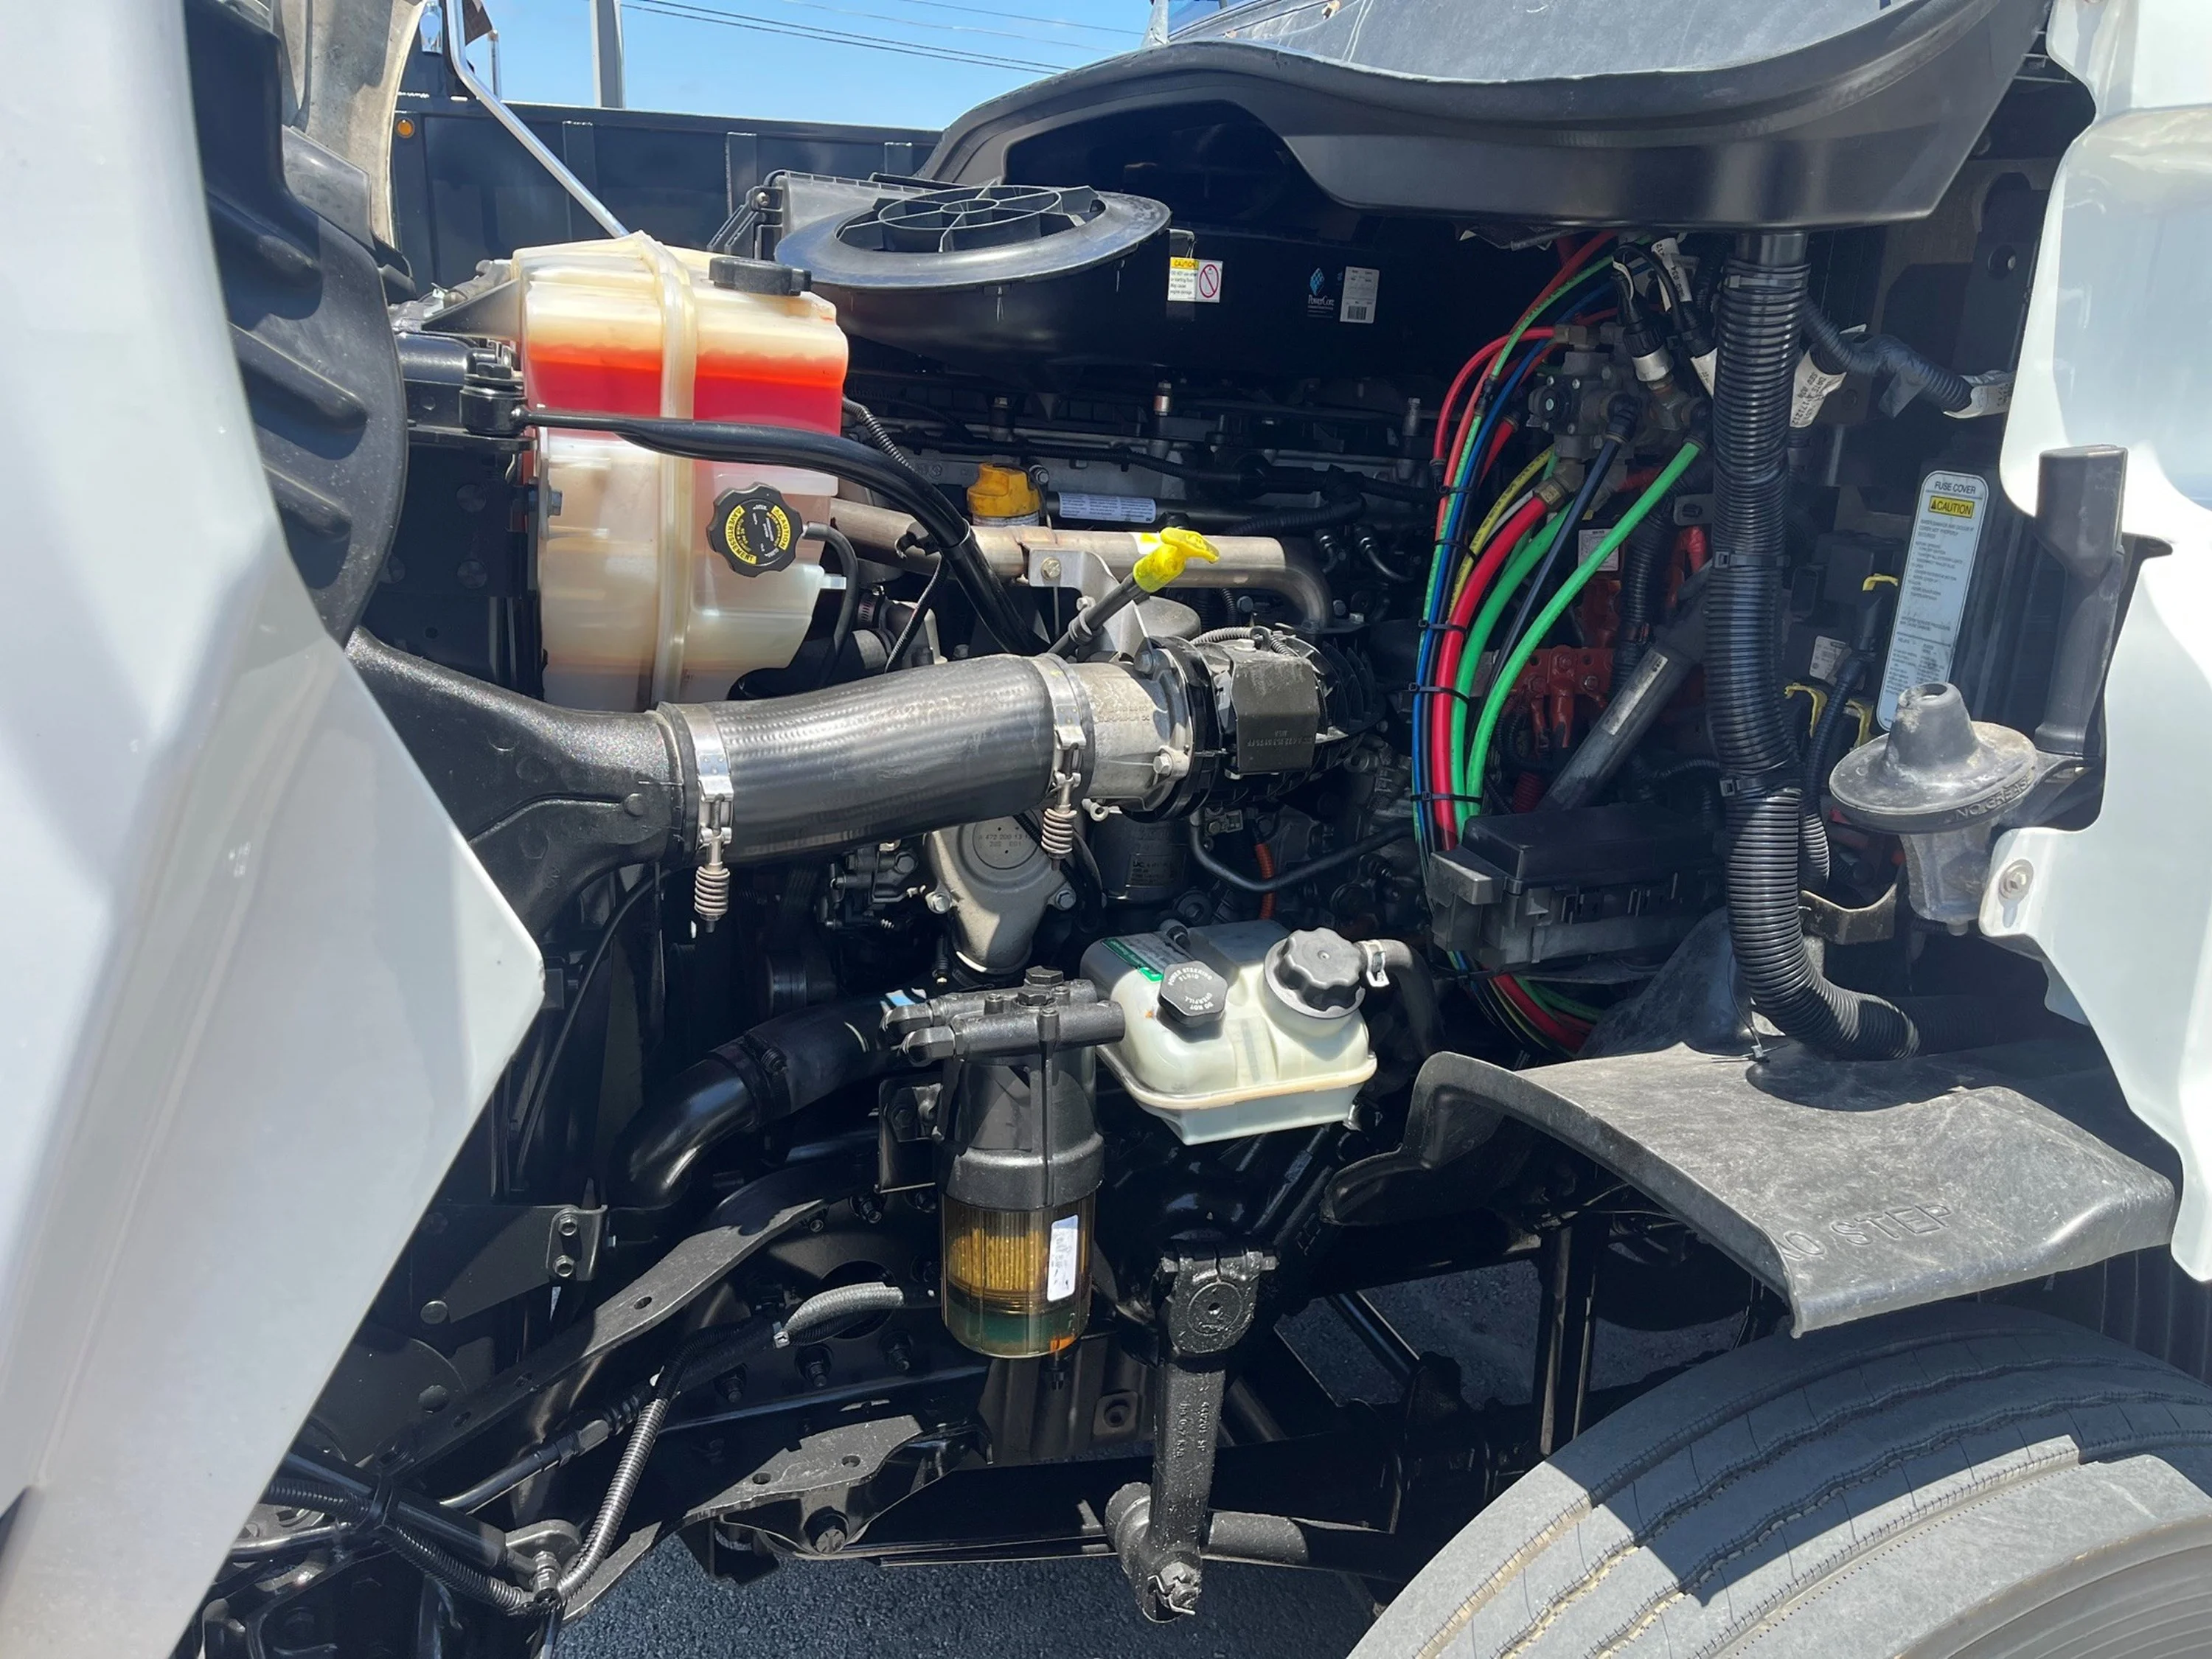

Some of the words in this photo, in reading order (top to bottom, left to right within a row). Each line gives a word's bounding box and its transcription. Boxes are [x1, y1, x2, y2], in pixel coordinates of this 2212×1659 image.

[1307, 293, 1335, 307] PowerCore
[1812, 376, 1826, 393] DATE
[1934, 481, 1952, 491] FUSE
[1952, 483, 1976, 494] COVER
[1937, 501, 1972, 515] CAUTION
[727, 512, 754, 561] AVERTISSEMENT
[778, 514, 789, 548] CAUTION
[1955, 803, 1981, 820] NO
[1168, 970, 1183, 986] POWER
[1182, 967, 1213, 981] STEERING
[1178, 973, 1199, 981] FLUID
[1185, 992, 1213, 1004] OVERFILL
[1204, 1001, 1214, 1009] DO
[1830, 1204, 1952, 1246] STEP
